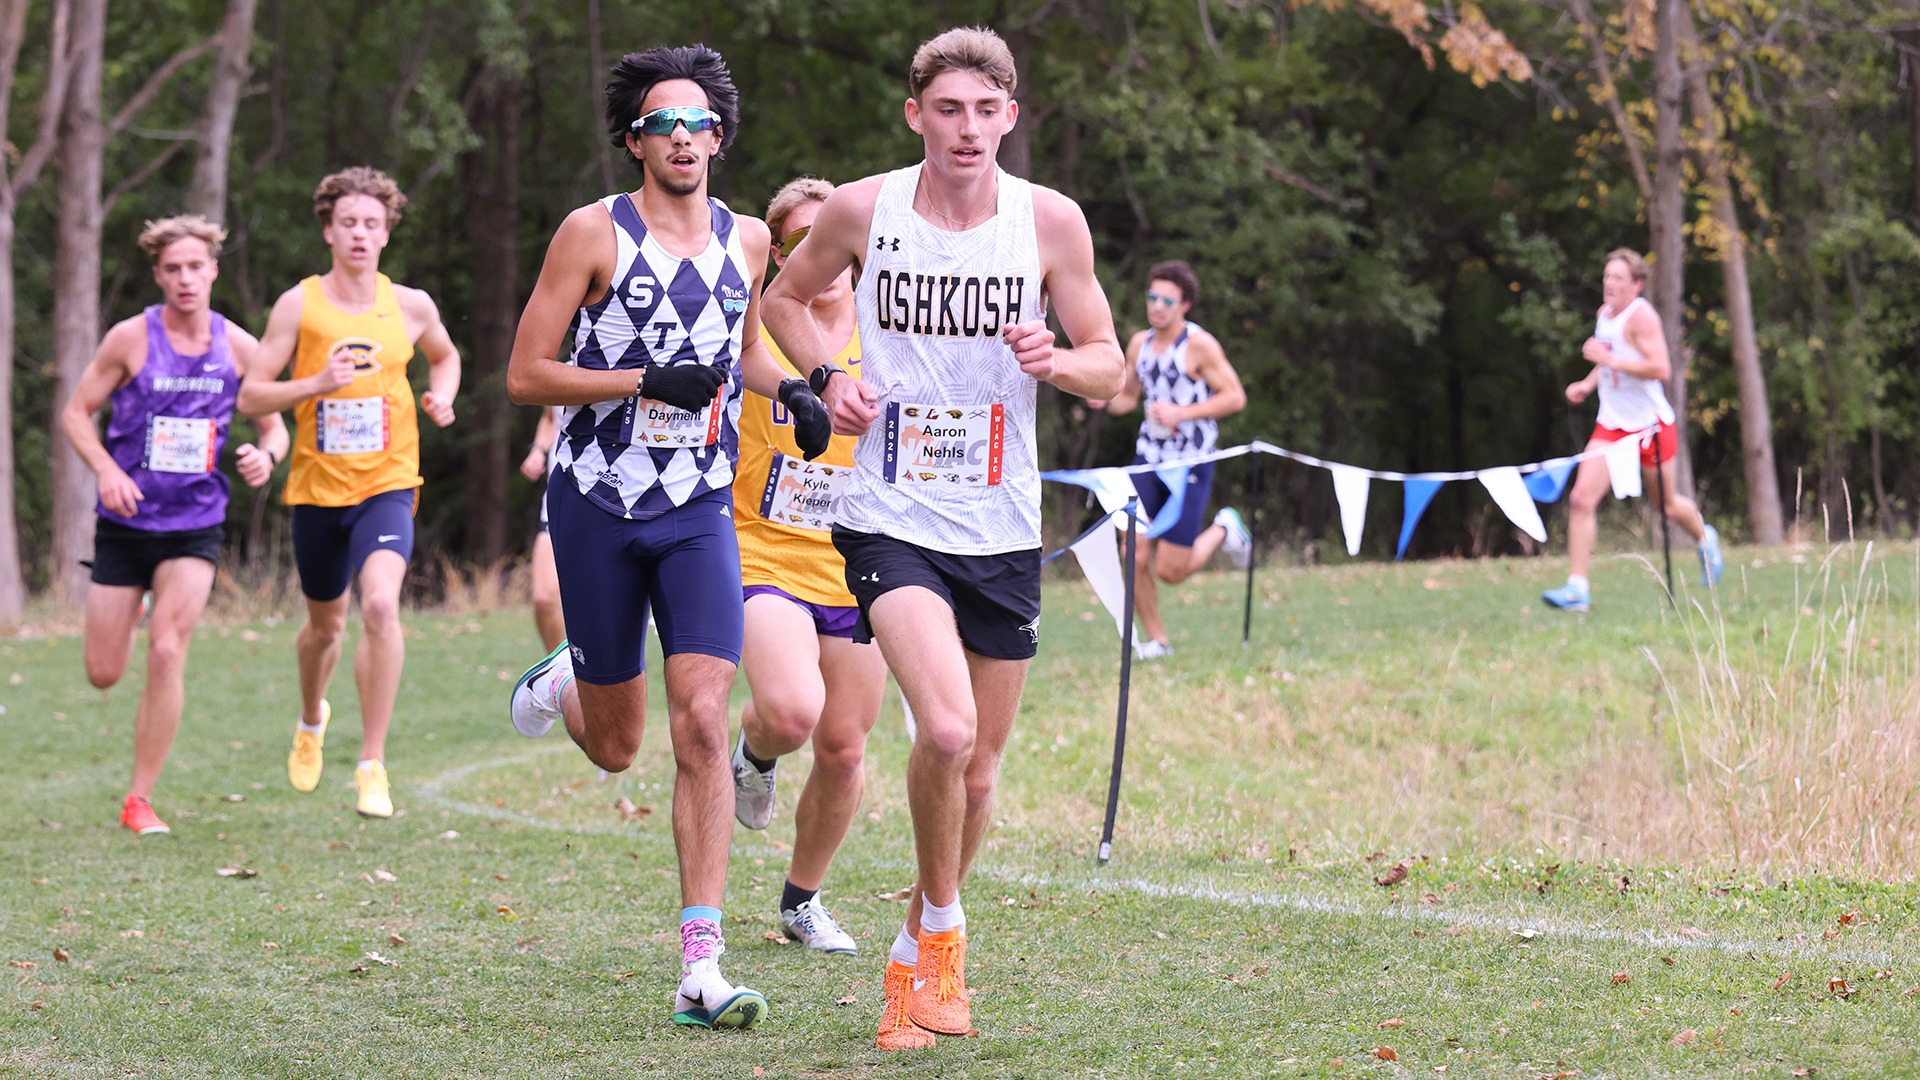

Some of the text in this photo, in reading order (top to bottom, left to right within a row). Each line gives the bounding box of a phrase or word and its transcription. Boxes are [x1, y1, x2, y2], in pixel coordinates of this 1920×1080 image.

[877, 270, 1024, 337] OSHKOSH
[625, 396, 634, 424] 025
[648, 409, 702, 423] Dayment
[887, 420, 895, 462] 2025
[922, 425, 967, 437] Aaron
[923, 446, 965, 458] Nehls
[992, 415, 1001, 473] WIAC XC
[764, 467, 778, 502] 2025
[803, 478, 830, 491] Kyle
[793, 493, 832, 508] Kieper
